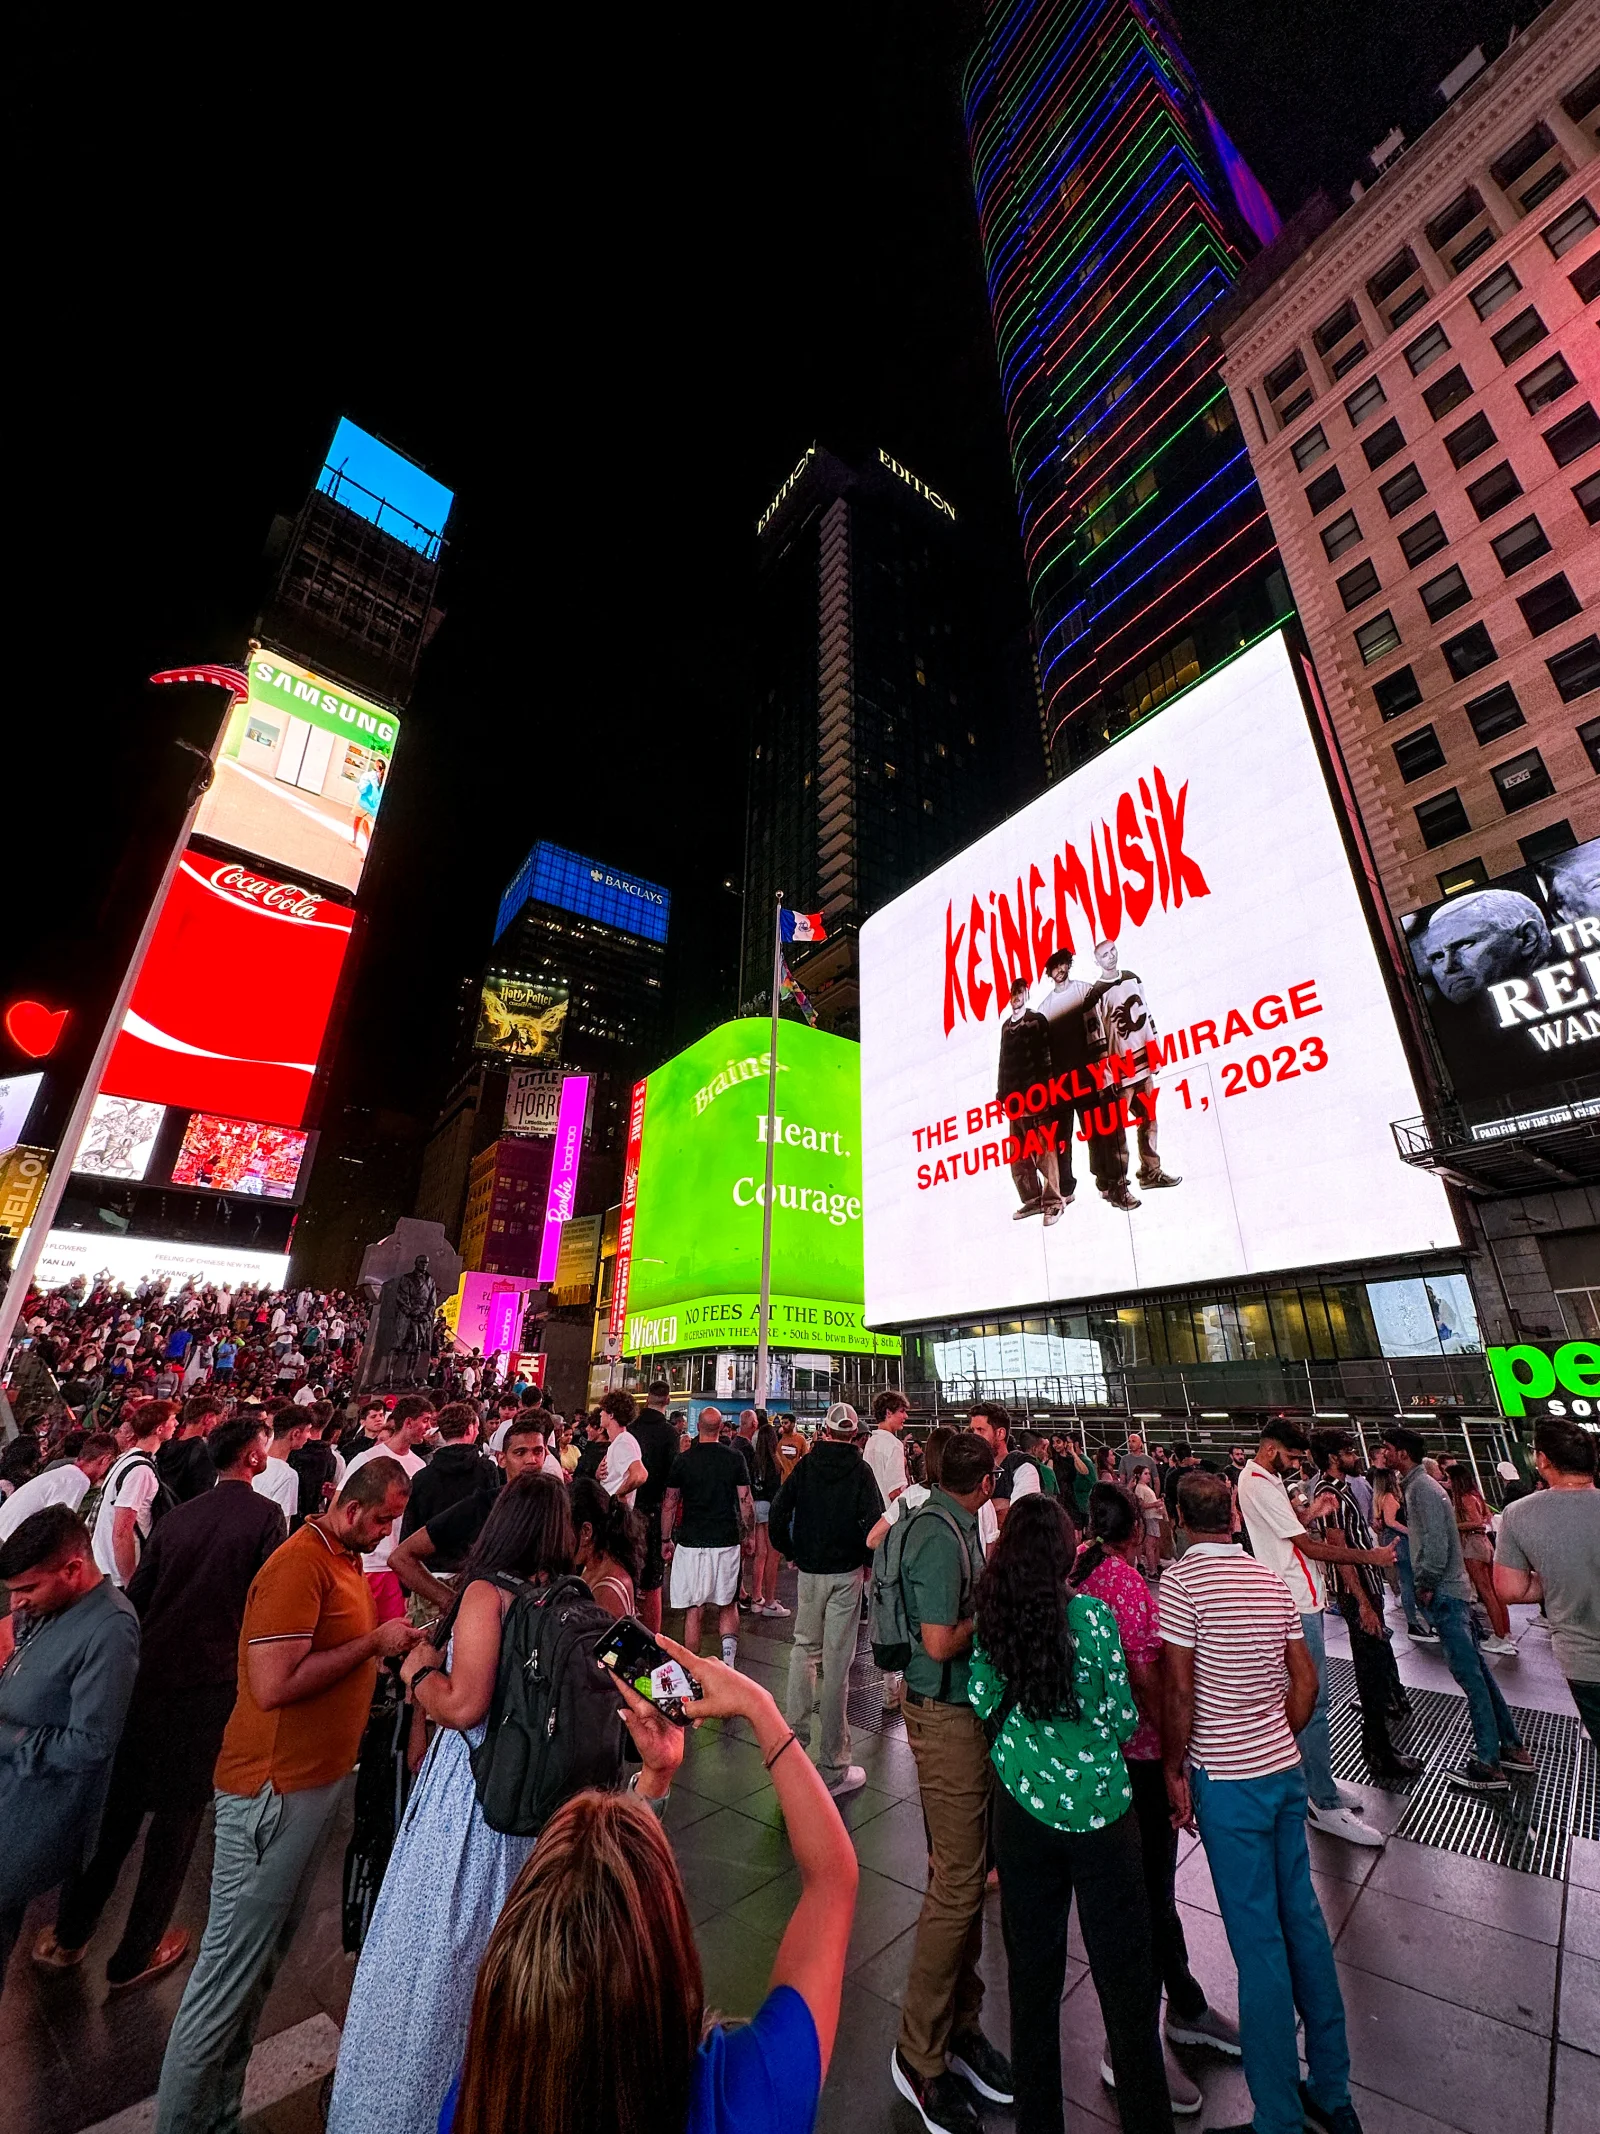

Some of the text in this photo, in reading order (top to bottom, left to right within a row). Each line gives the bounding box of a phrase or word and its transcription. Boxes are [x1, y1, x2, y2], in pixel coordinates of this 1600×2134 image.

[878, 448, 956, 520] EDITION
[254, 661, 395, 742] SAMSUNG
[210, 864, 326, 920] Coca-Cola
[605, 875, 663, 905] BARCLAYS
[500, 987, 527, 1002] Harry
[525, 989, 553, 1006] Potter
[518, 1072, 558, 1088] LITTLE
[912, 980, 1324, 1153] THE BROOKLYN MIRAGE
[631, 1097, 644, 1143] STORE
[916, 1036, 1330, 1191] SATURDAY, JULY 1, 2023
[755, 1115, 851, 1157] Heart.
[547, 1125, 577, 1223] Barbie boohoo
[733, 1176, 861, 1226] Courage
[49, 1243, 87, 1253] FLOWERS
[620, 1216, 633, 1254] FREE
[42, 1258, 75, 1267] YAN LIN
[155, 1254, 184, 1263] FEELING
[196, 1258, 225, 1267] CHINESE
[163, 1269, 188, 1278] WANG
[499, 1308, 512, 1346] boohoo
[685, 1308, 700, 1325] NO
[702, 1304, 742, 1322] FEES
[750, 1303, 777, 1320] AT
[783, 1305, 818, 1324] THE
[823, 1310, 856, 1328] BOX
[689, 1327, 725, 1340] GERSHWIN
[790, 1330, 809, 1340] 50th
[812, 1331, 822, 1341] St.
[825, 1331, 845, 1343] btwn
[848, 1334, 870, 1347] Bway
[881, 1338, 894, 1348] 8th
[1487, 1341, 1600, 1416] pe
[1547, 1399, 1600, 1416] SO
